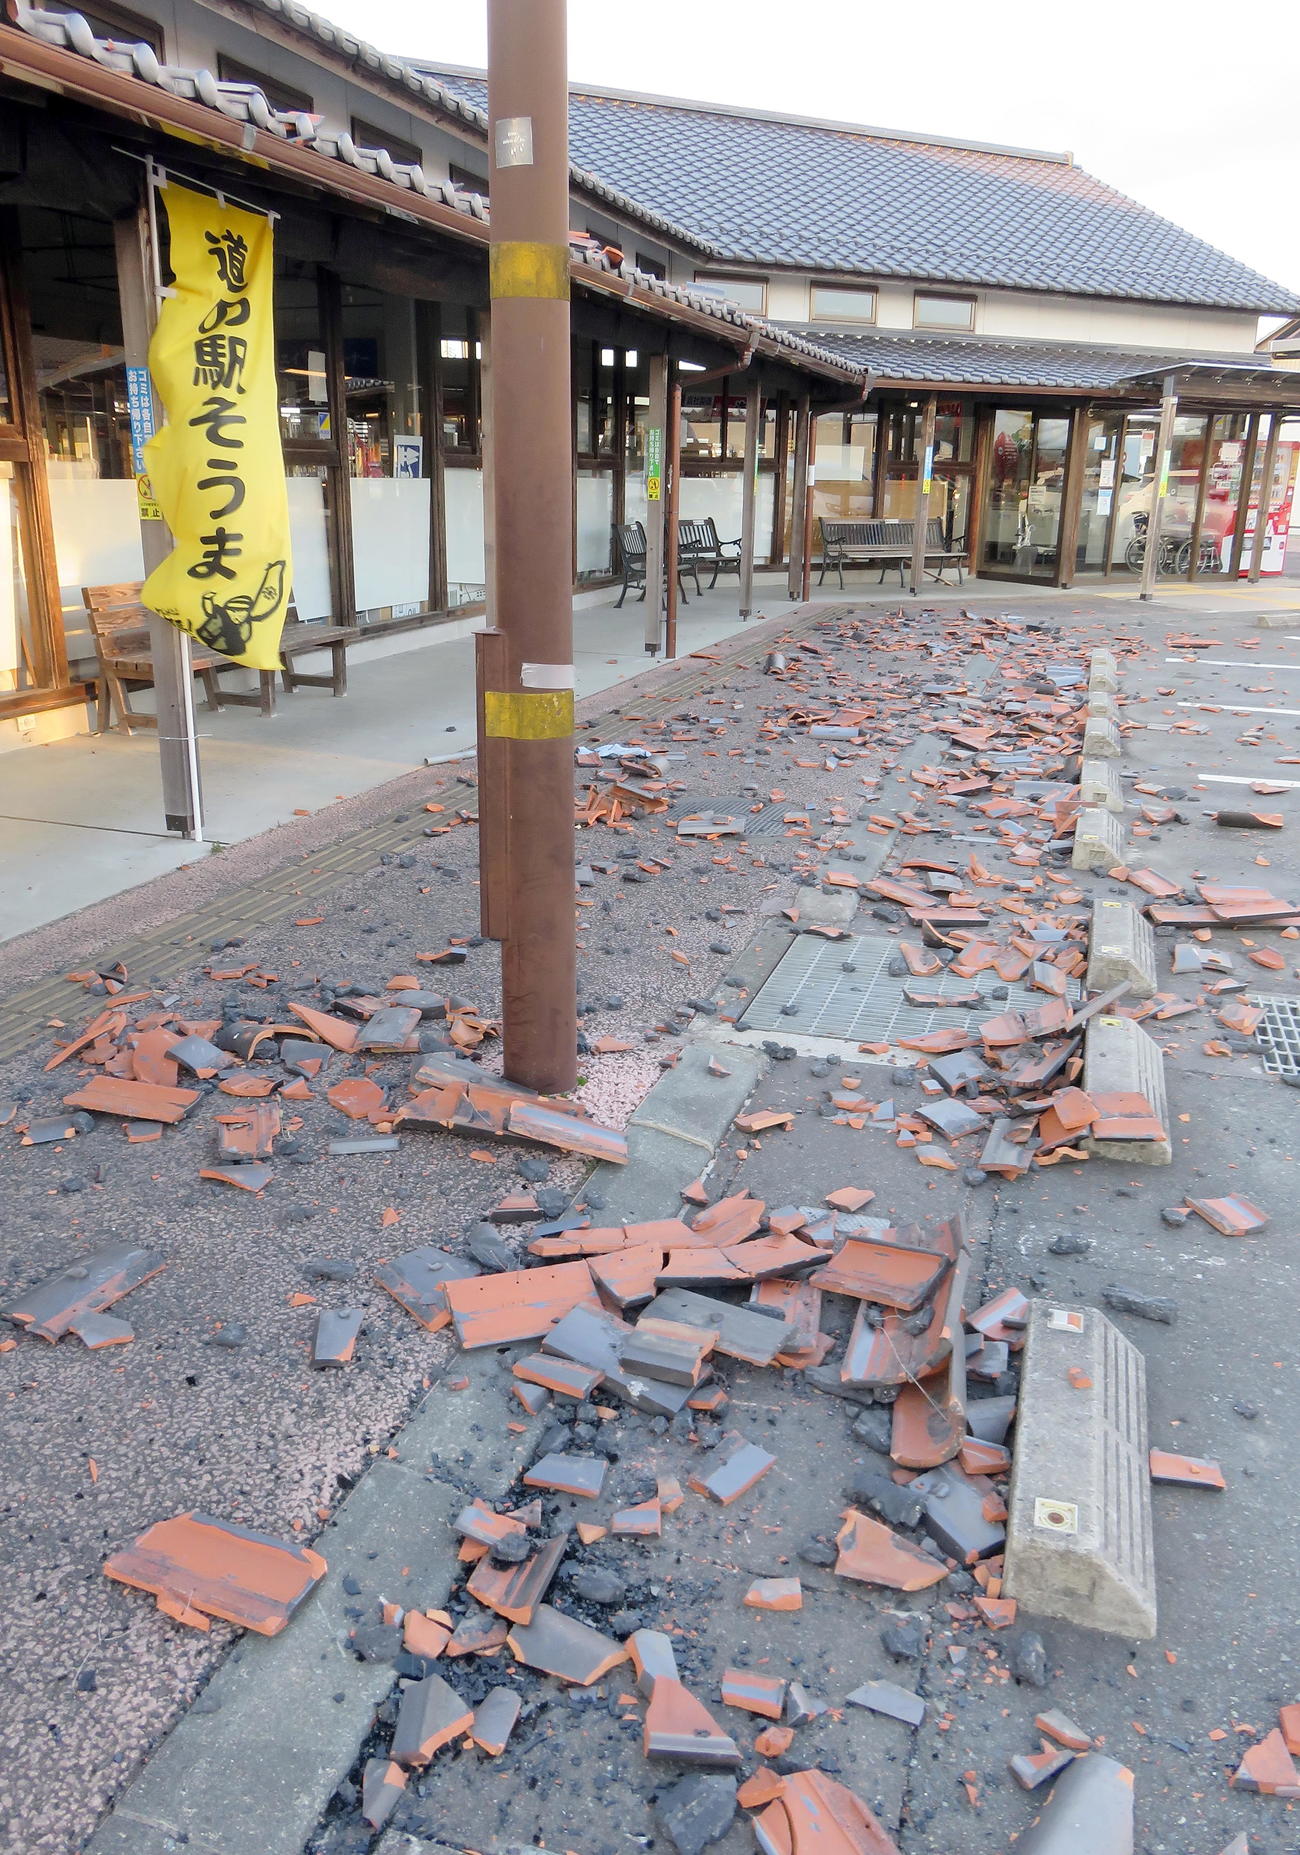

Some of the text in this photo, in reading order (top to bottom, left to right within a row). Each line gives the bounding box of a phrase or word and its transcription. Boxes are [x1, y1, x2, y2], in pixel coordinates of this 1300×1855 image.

[187, 228, 251, 581] 道の駅そうま
